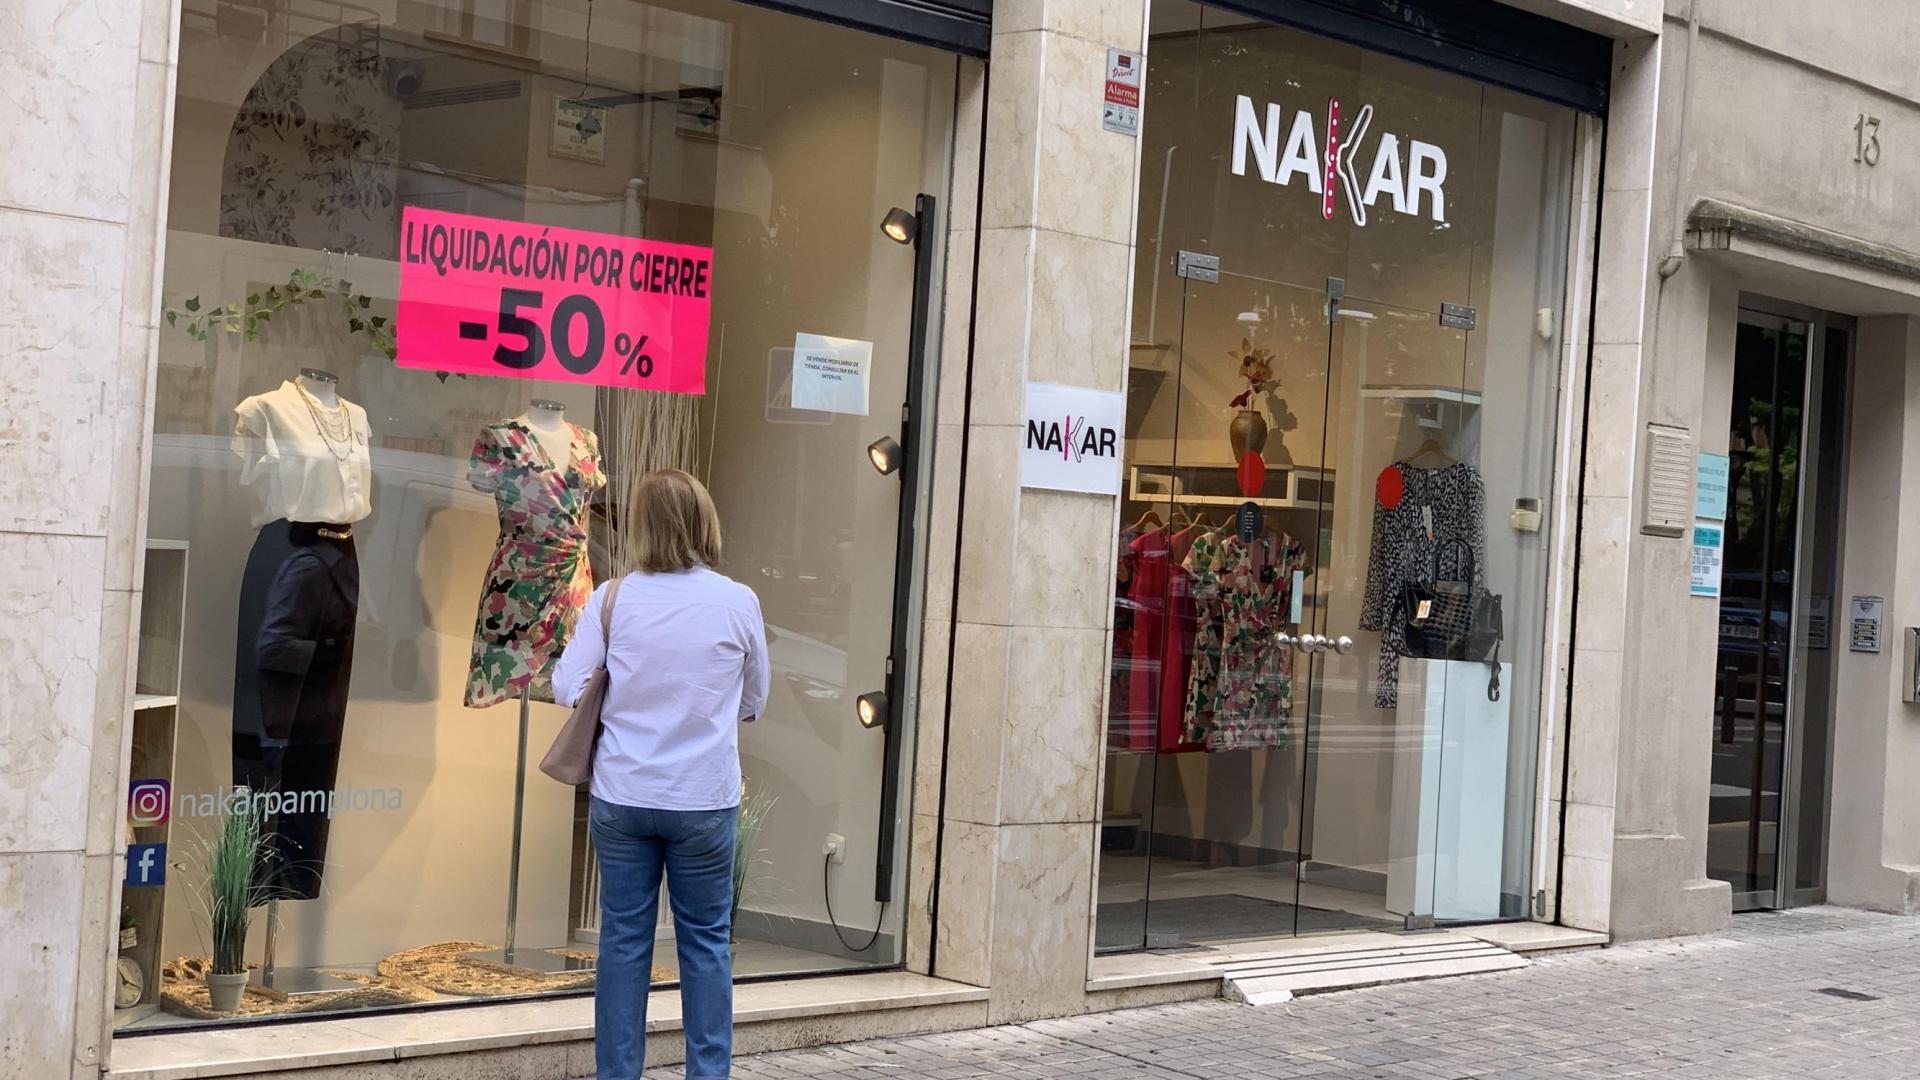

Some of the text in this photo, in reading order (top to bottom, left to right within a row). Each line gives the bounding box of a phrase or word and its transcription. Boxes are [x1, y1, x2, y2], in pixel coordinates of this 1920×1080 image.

[1107, 84, 1137, 100] Alarma
[1231, 94, 1448, 227] NAKAR
[1853, 113, 1881, 168] 13
[406, 221, 709, 299] LIQUIDACIÓN POR CIERRE
[1027, 415, 1117, 463] NAKAR
[179, 785, 403, 822] nakarpamplona
